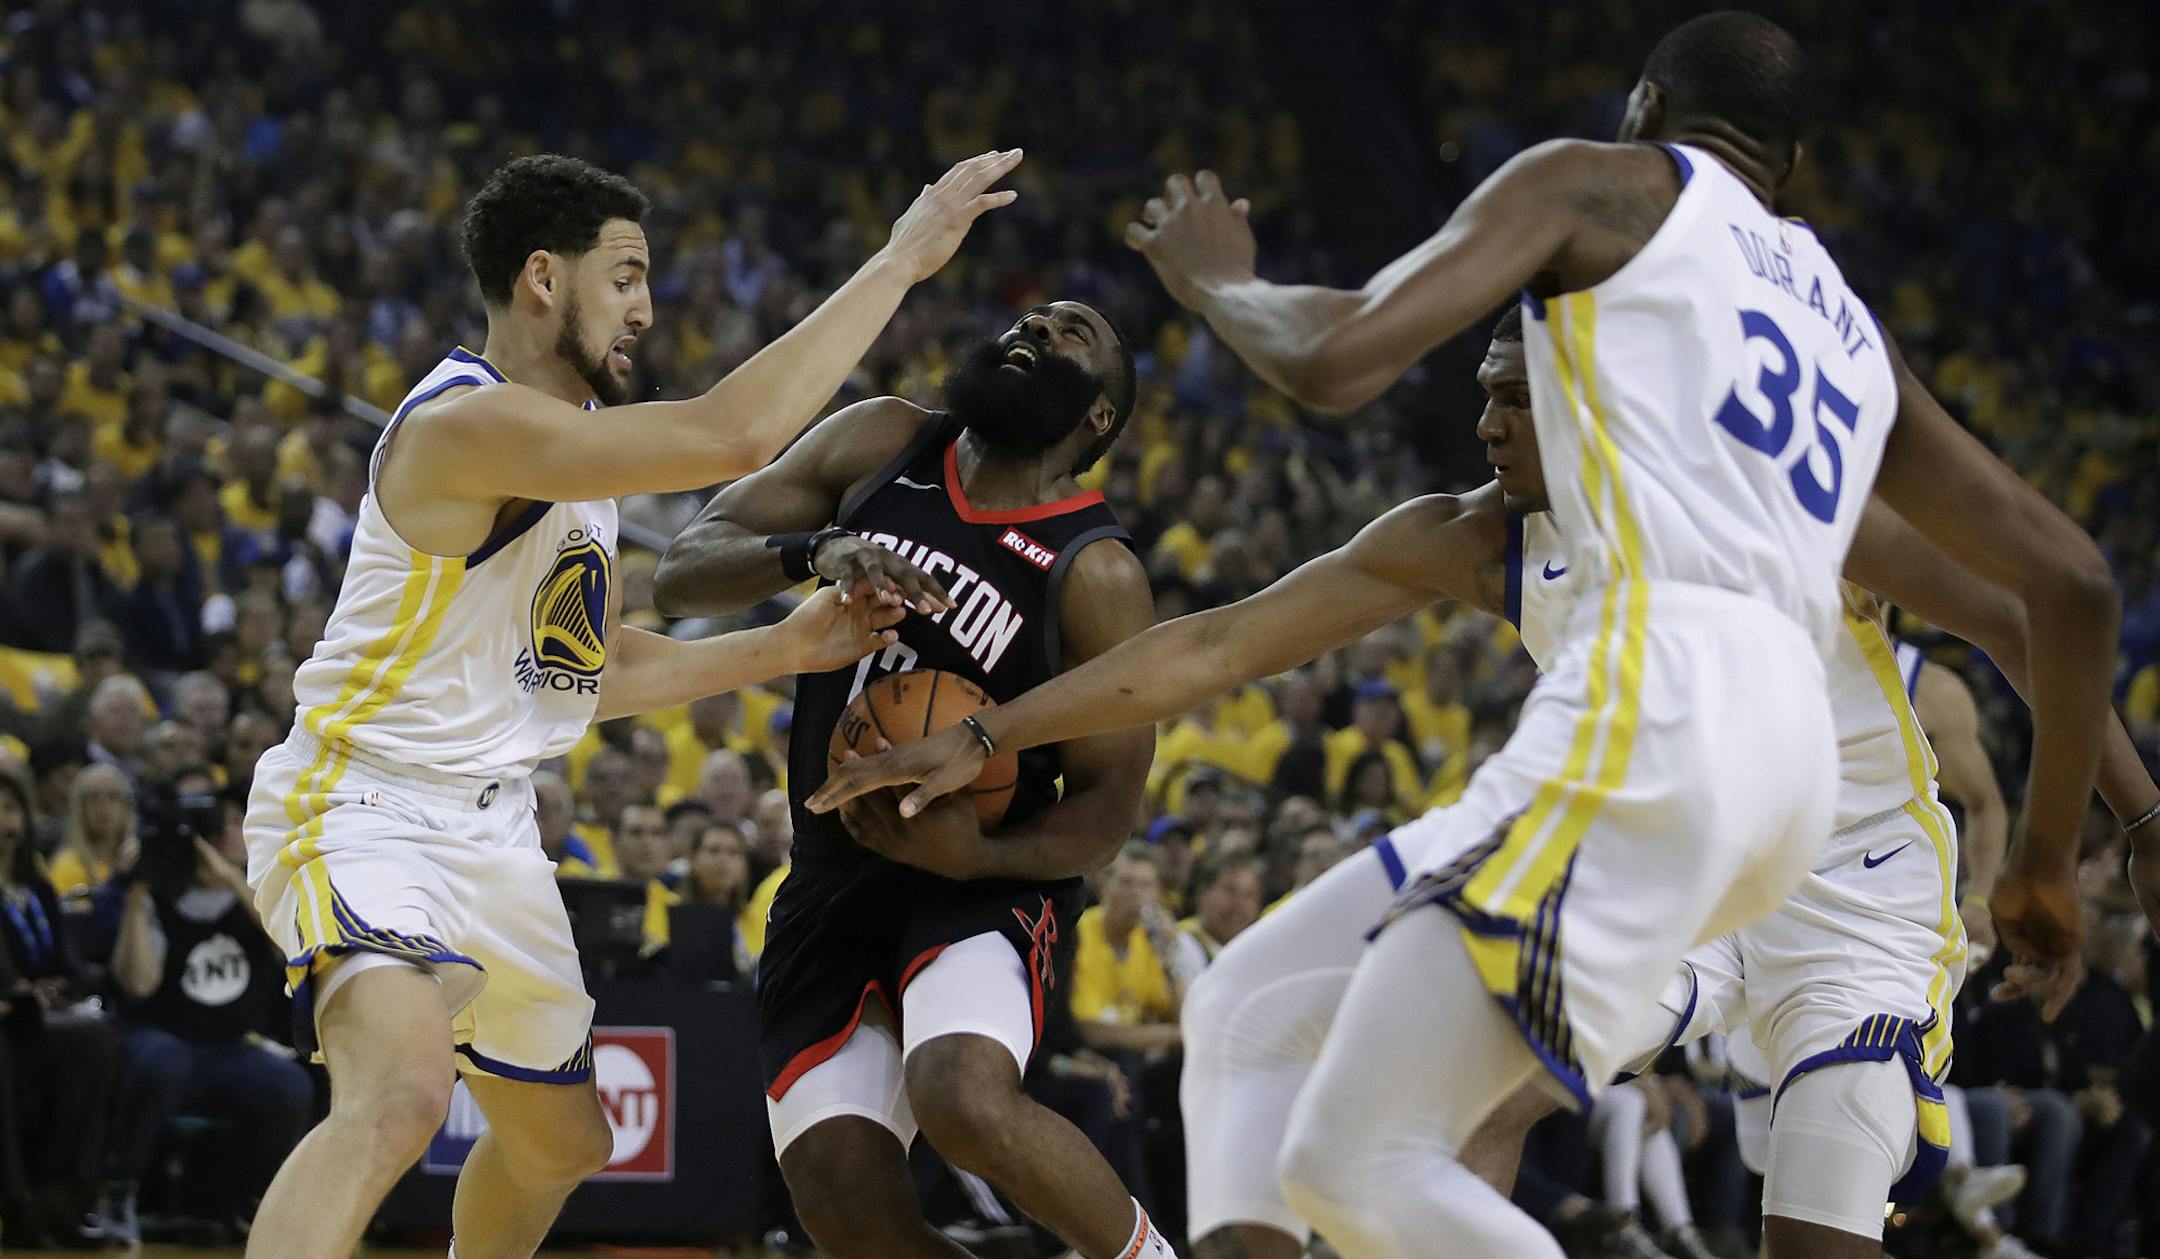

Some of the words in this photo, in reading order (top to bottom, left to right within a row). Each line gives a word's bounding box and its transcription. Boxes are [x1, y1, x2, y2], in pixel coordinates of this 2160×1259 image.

[1729, 223, 1873, 361] DURANT
[1714, 308, 1859, 524] 35
[859, 531, 1023, 674] STON
[597, 1086, 657, 1128] NT
